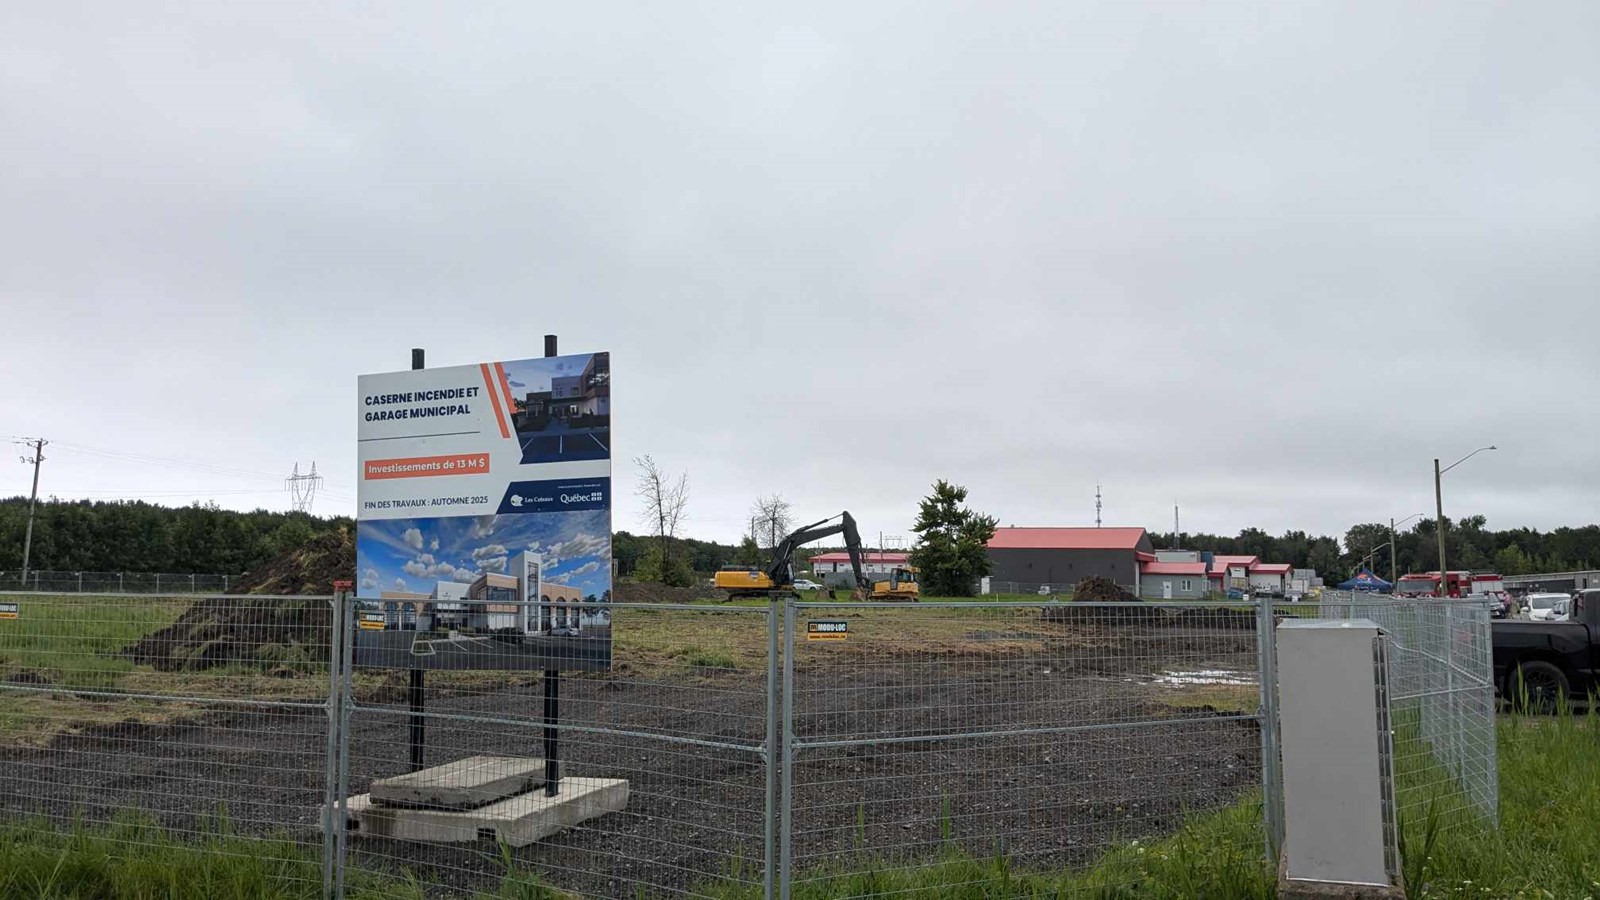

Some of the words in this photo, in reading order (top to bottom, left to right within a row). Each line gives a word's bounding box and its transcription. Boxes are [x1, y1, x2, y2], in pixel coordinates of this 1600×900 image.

[365, 392, 413, 406] CASERNE
[414, 388, 465, 402] INCENDIE
[466, 387, 479, 397] ET
[365, 409, 408, 422] GARAGE
[409, 404, 471, 418] MUNICIPAL
[368, 462, 441, 473] Investissements
[443, 460, 455, 469] de
[456, 459, 466, 468] 13
[468, 459, 477, 468] M
[479, 458, 485, 468] $
[364, 501, 376, 509] FIN
[377, 500, 391, 509] DES
[392, 499, 427, 508] TRAVAUX
[431, 497, 470, 506] AUTOMNE
[470, 496, 488, 504] 2025
[560, 493, 591, 504] Québec
[817, 623, 846, 632] MODU-LOC
